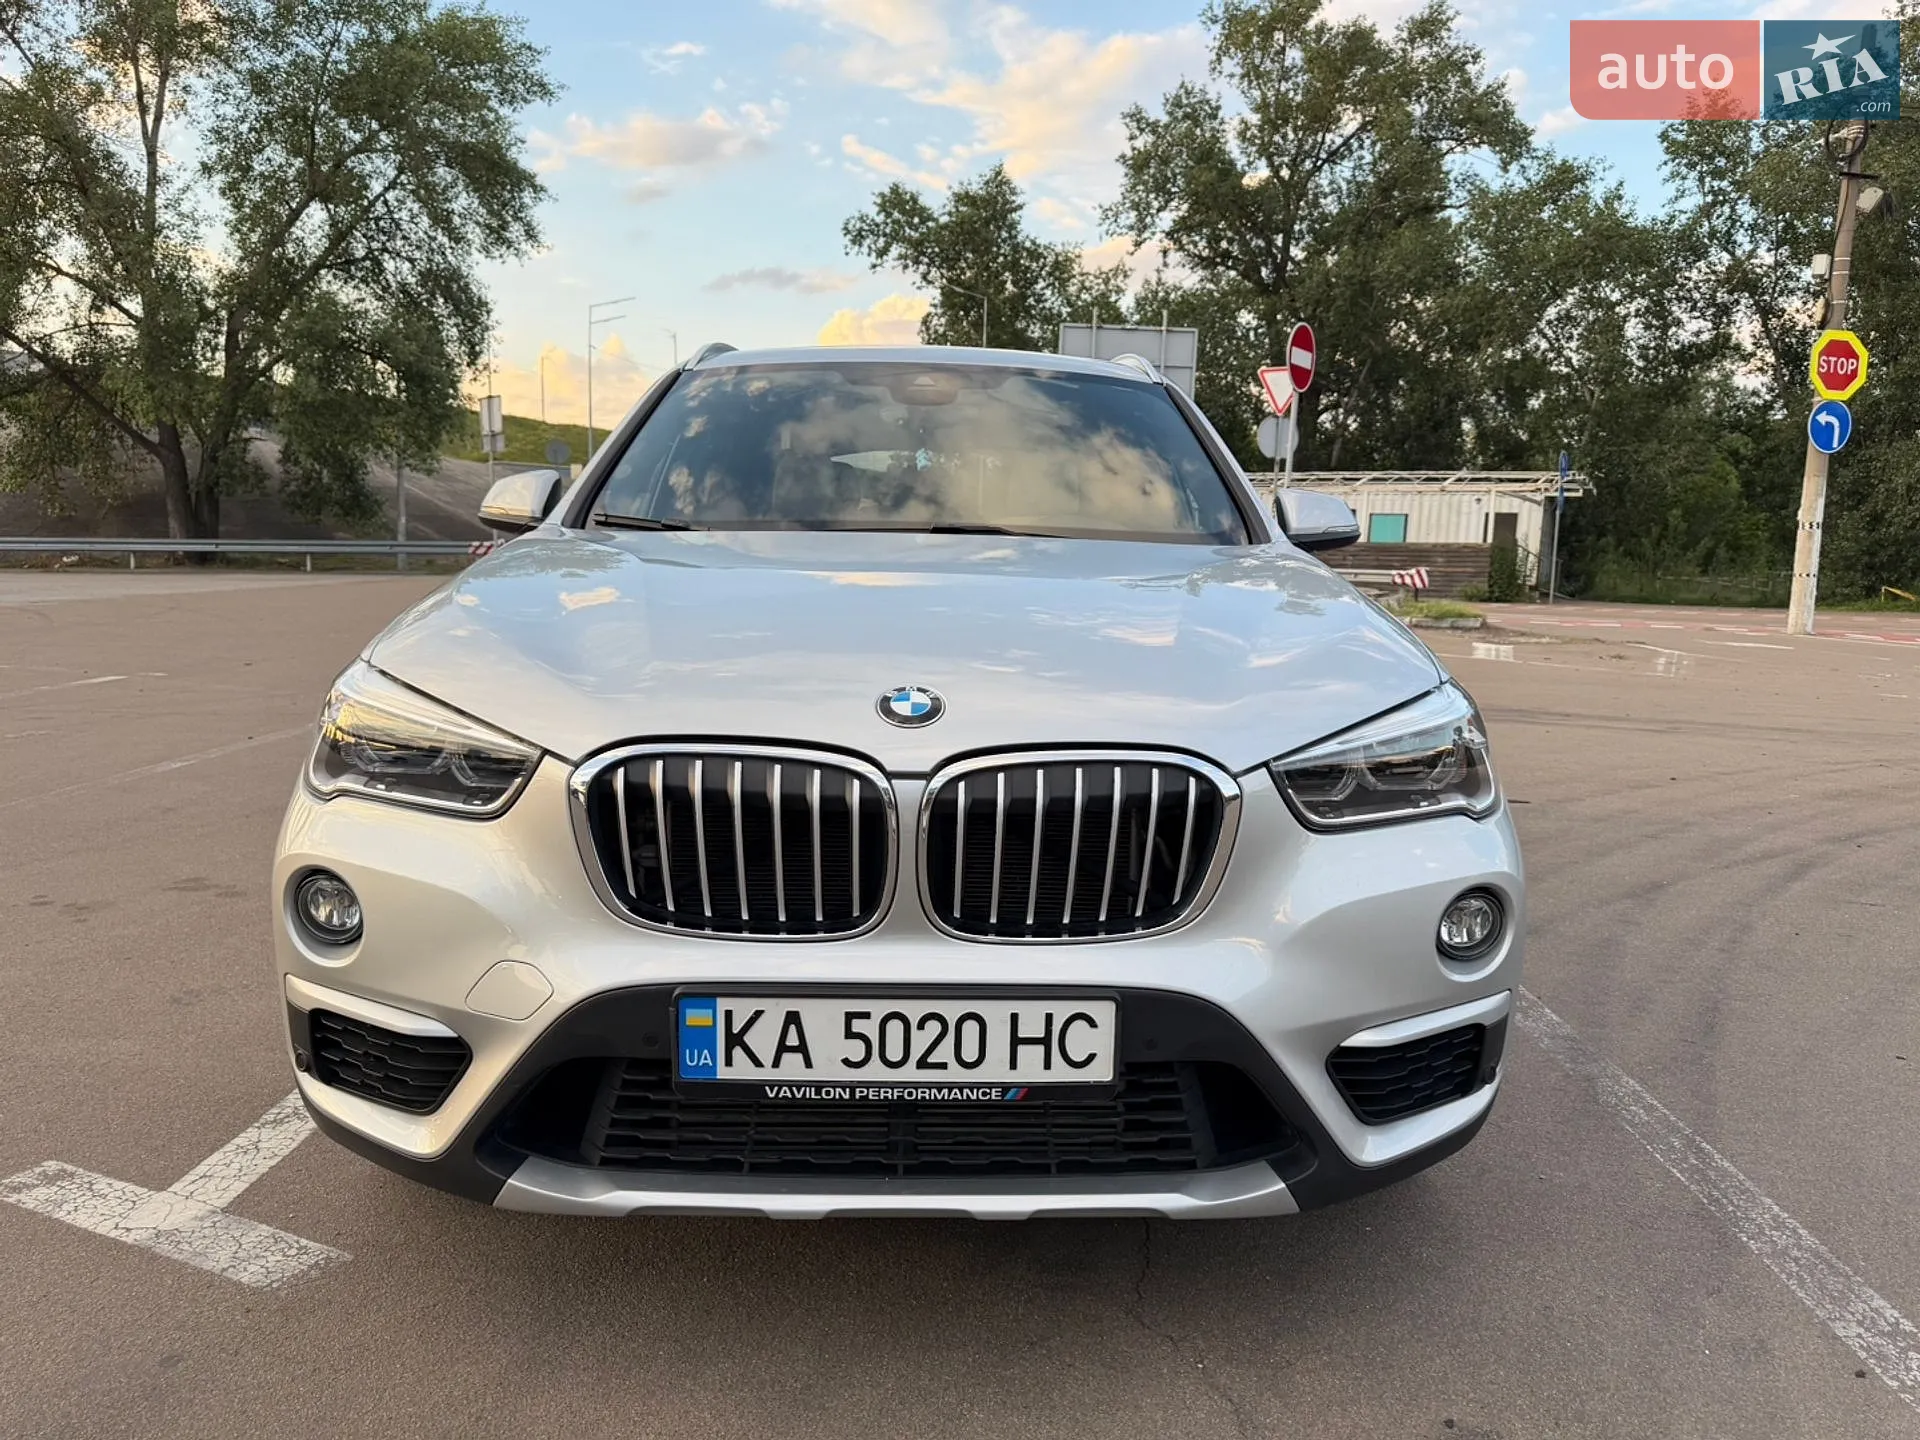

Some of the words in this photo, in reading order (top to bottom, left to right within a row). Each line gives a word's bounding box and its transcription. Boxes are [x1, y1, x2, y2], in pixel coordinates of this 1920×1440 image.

[1819, 355, 1857, 375] STOP
[724, 1009, 814, 1069] KA
[840, 1010, 987, 1070] 5020
[1009, 1011, 1099, 1070] HC
[685, 1049, 713, 1067] UA
[764, 1085, 850, 1099] VAVILON
[856, 1087, 1002, 1100] PERFORMANCE
